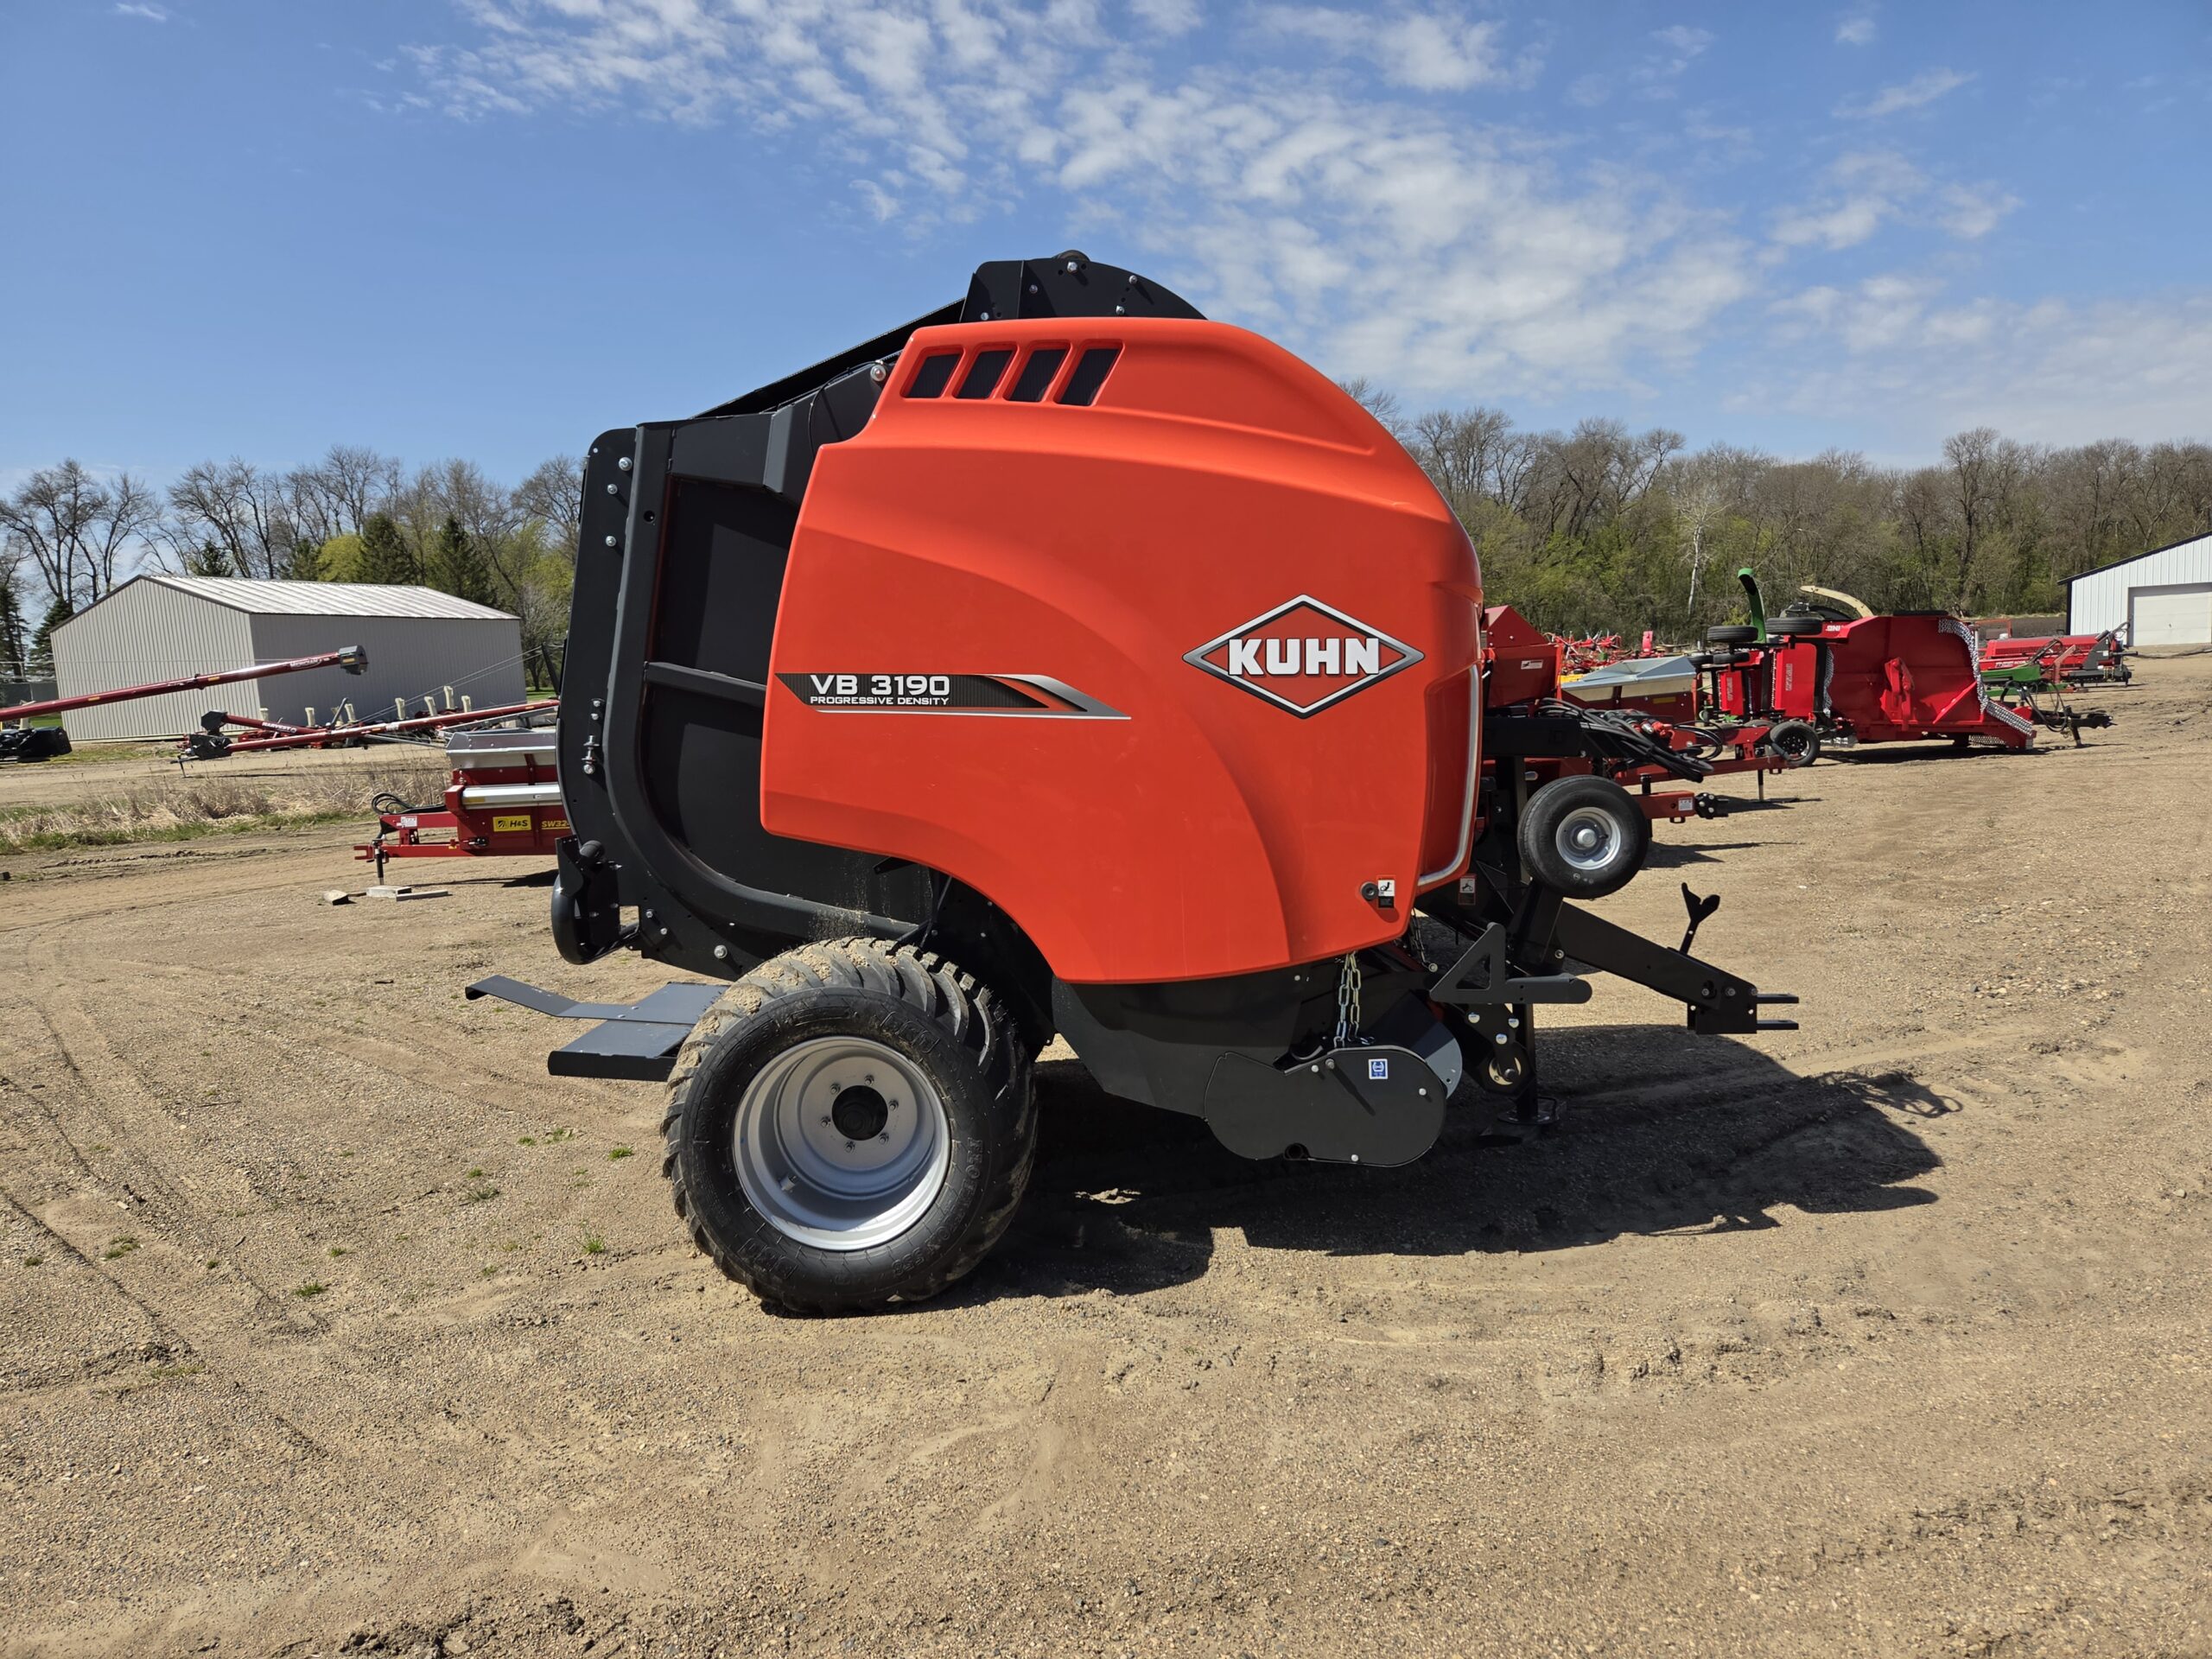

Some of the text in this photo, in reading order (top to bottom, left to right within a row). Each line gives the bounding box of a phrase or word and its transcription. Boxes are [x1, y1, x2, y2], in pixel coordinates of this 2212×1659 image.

[1228, 638, 1380, 676] KUHN
[810, 674, 950, 696] VB 3190
[810, 696, 950, 706] PROGRESSIVE DENSITY
[510, 819, 528, 828] H&S
